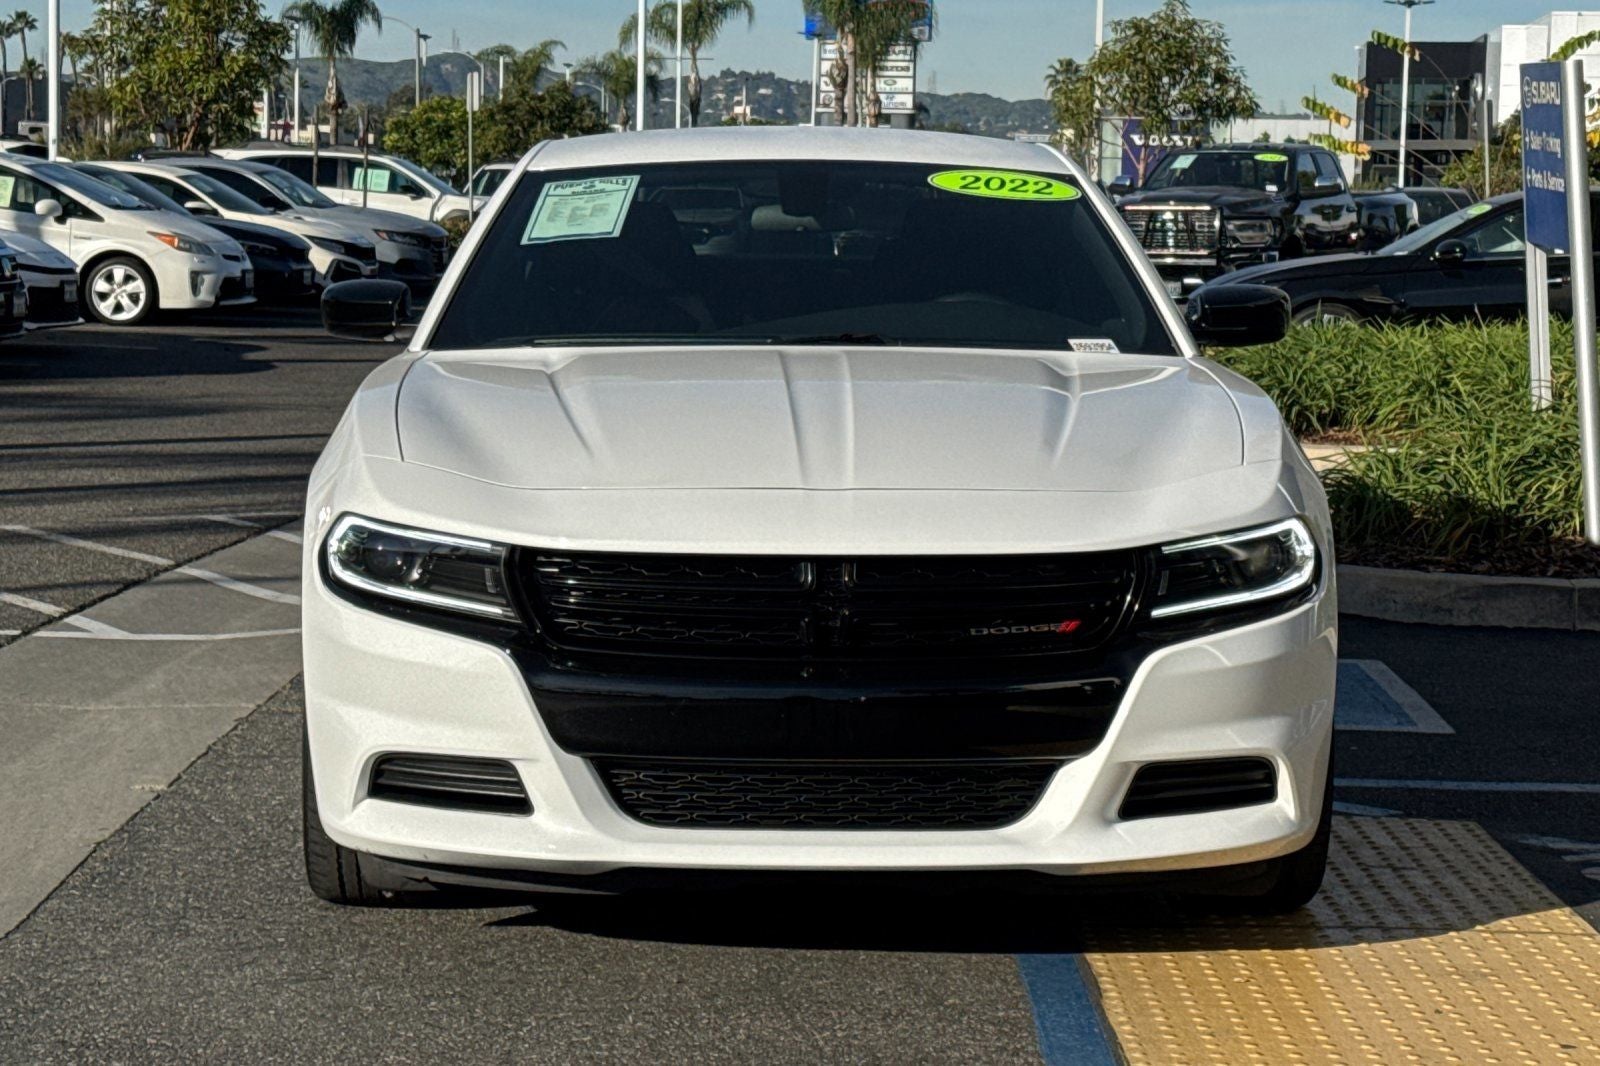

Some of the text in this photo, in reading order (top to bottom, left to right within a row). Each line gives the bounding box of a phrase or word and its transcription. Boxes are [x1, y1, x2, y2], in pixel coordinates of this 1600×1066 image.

[1531, 81, 1561, 105] SUBARU
[959, 175, 1054, 195] 2022
[1532, 167, 1543, 189] Parts
[1548, 170, 1565, 192] Service
[970, 623, 1061, 635] DODGE
